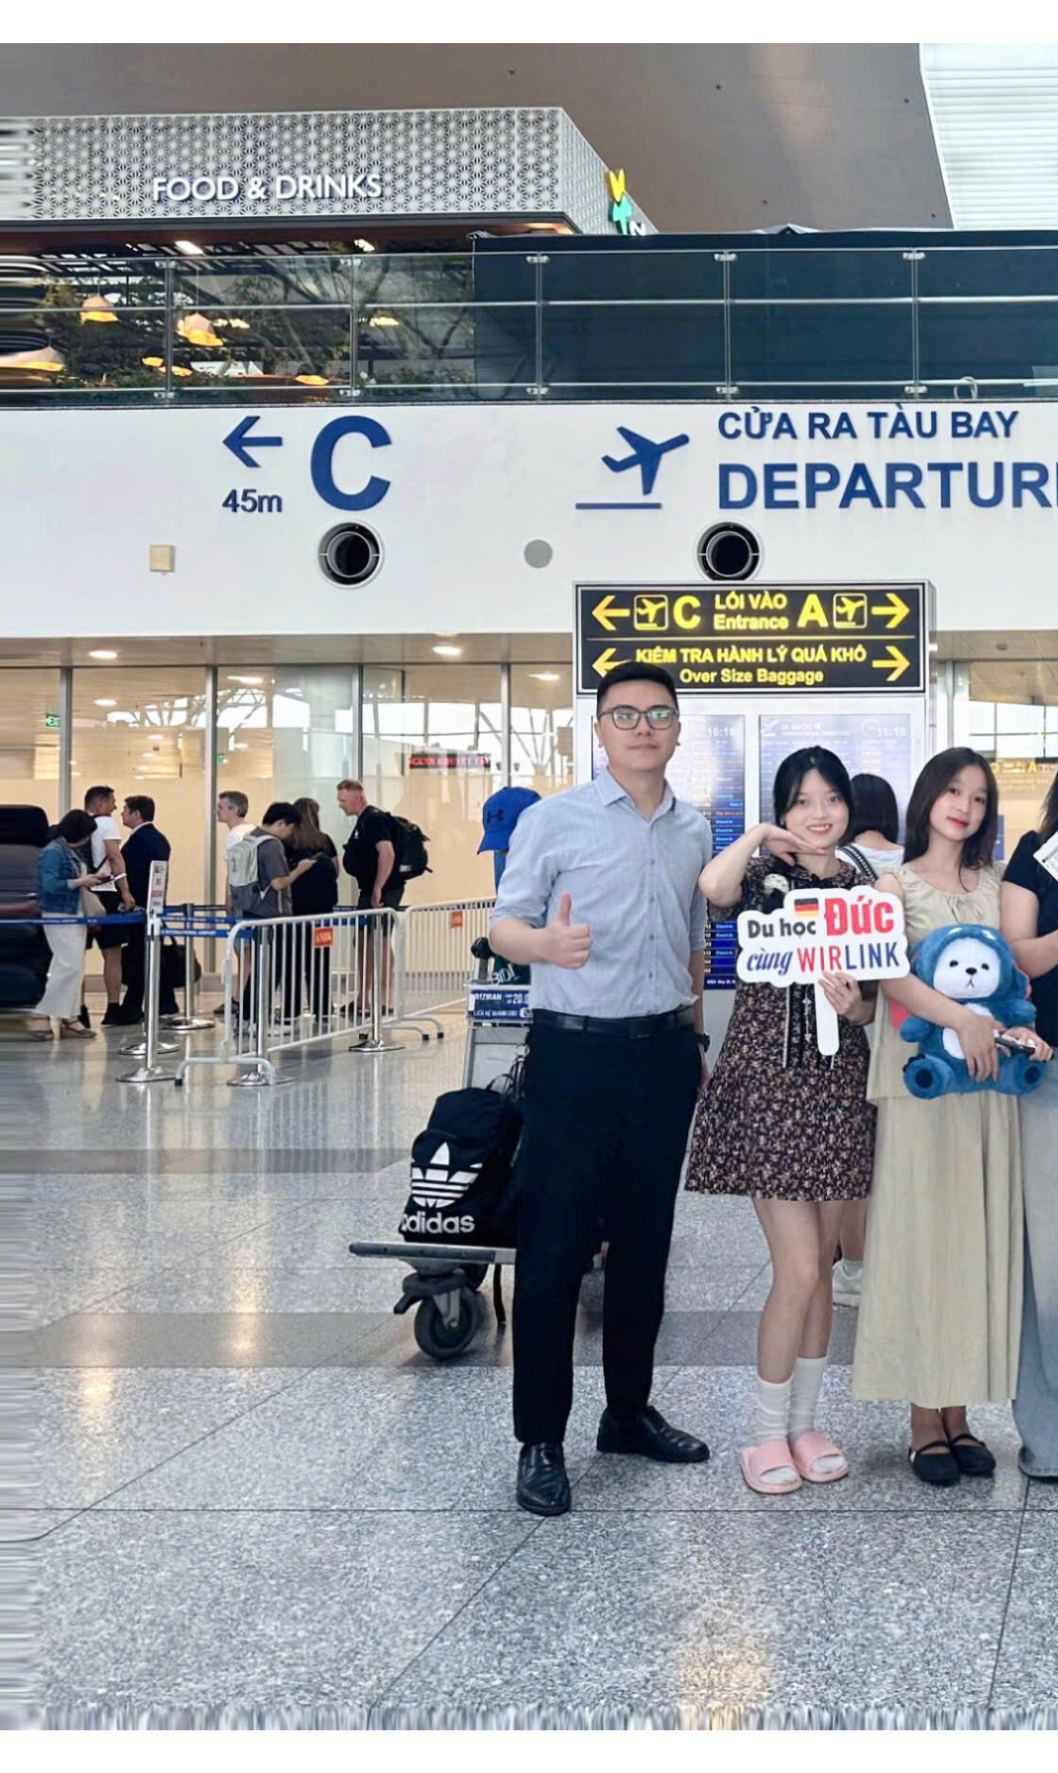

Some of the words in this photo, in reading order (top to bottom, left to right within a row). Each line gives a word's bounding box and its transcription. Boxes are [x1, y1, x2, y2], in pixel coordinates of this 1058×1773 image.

[153, 176, 240, 202] FOOD
[245, 175, 267, 201] &
[275, 173, 381, 200] DRINKS
[718, 406, 798, 440] CỬA
[808, 411, 857, 439] RA
[868, 403, 939, 439] TÀU
[951, 410, 1019, 438] BAY
[310, 415, 391, 511] C
[222, 488, 283, 513] 45m
[673, 594, 701, 630] C
[748, 591, 788, 610] VÀO
[797, 593, 828, 628] A
[713, 613, 790, 631] Entrance
[680, 648, 715, 663] TRA
[717, 645, 764, 662] HÀNH
[767, 645, 788, 662] LÝ
[791, 644, 828, 663] QUÁ
[680, 669, 716, 683] Over
[721, 669, 753, 682] Size
[756, 668, 824, 685] Baggage
[747, 919, 774, 939] Du
[780, 918, 817, 938] học
[824, 895, 895, 937] Đức
[746, 948, 794, 976] cùng
[797, 941, 900, 973] WIRLINK
